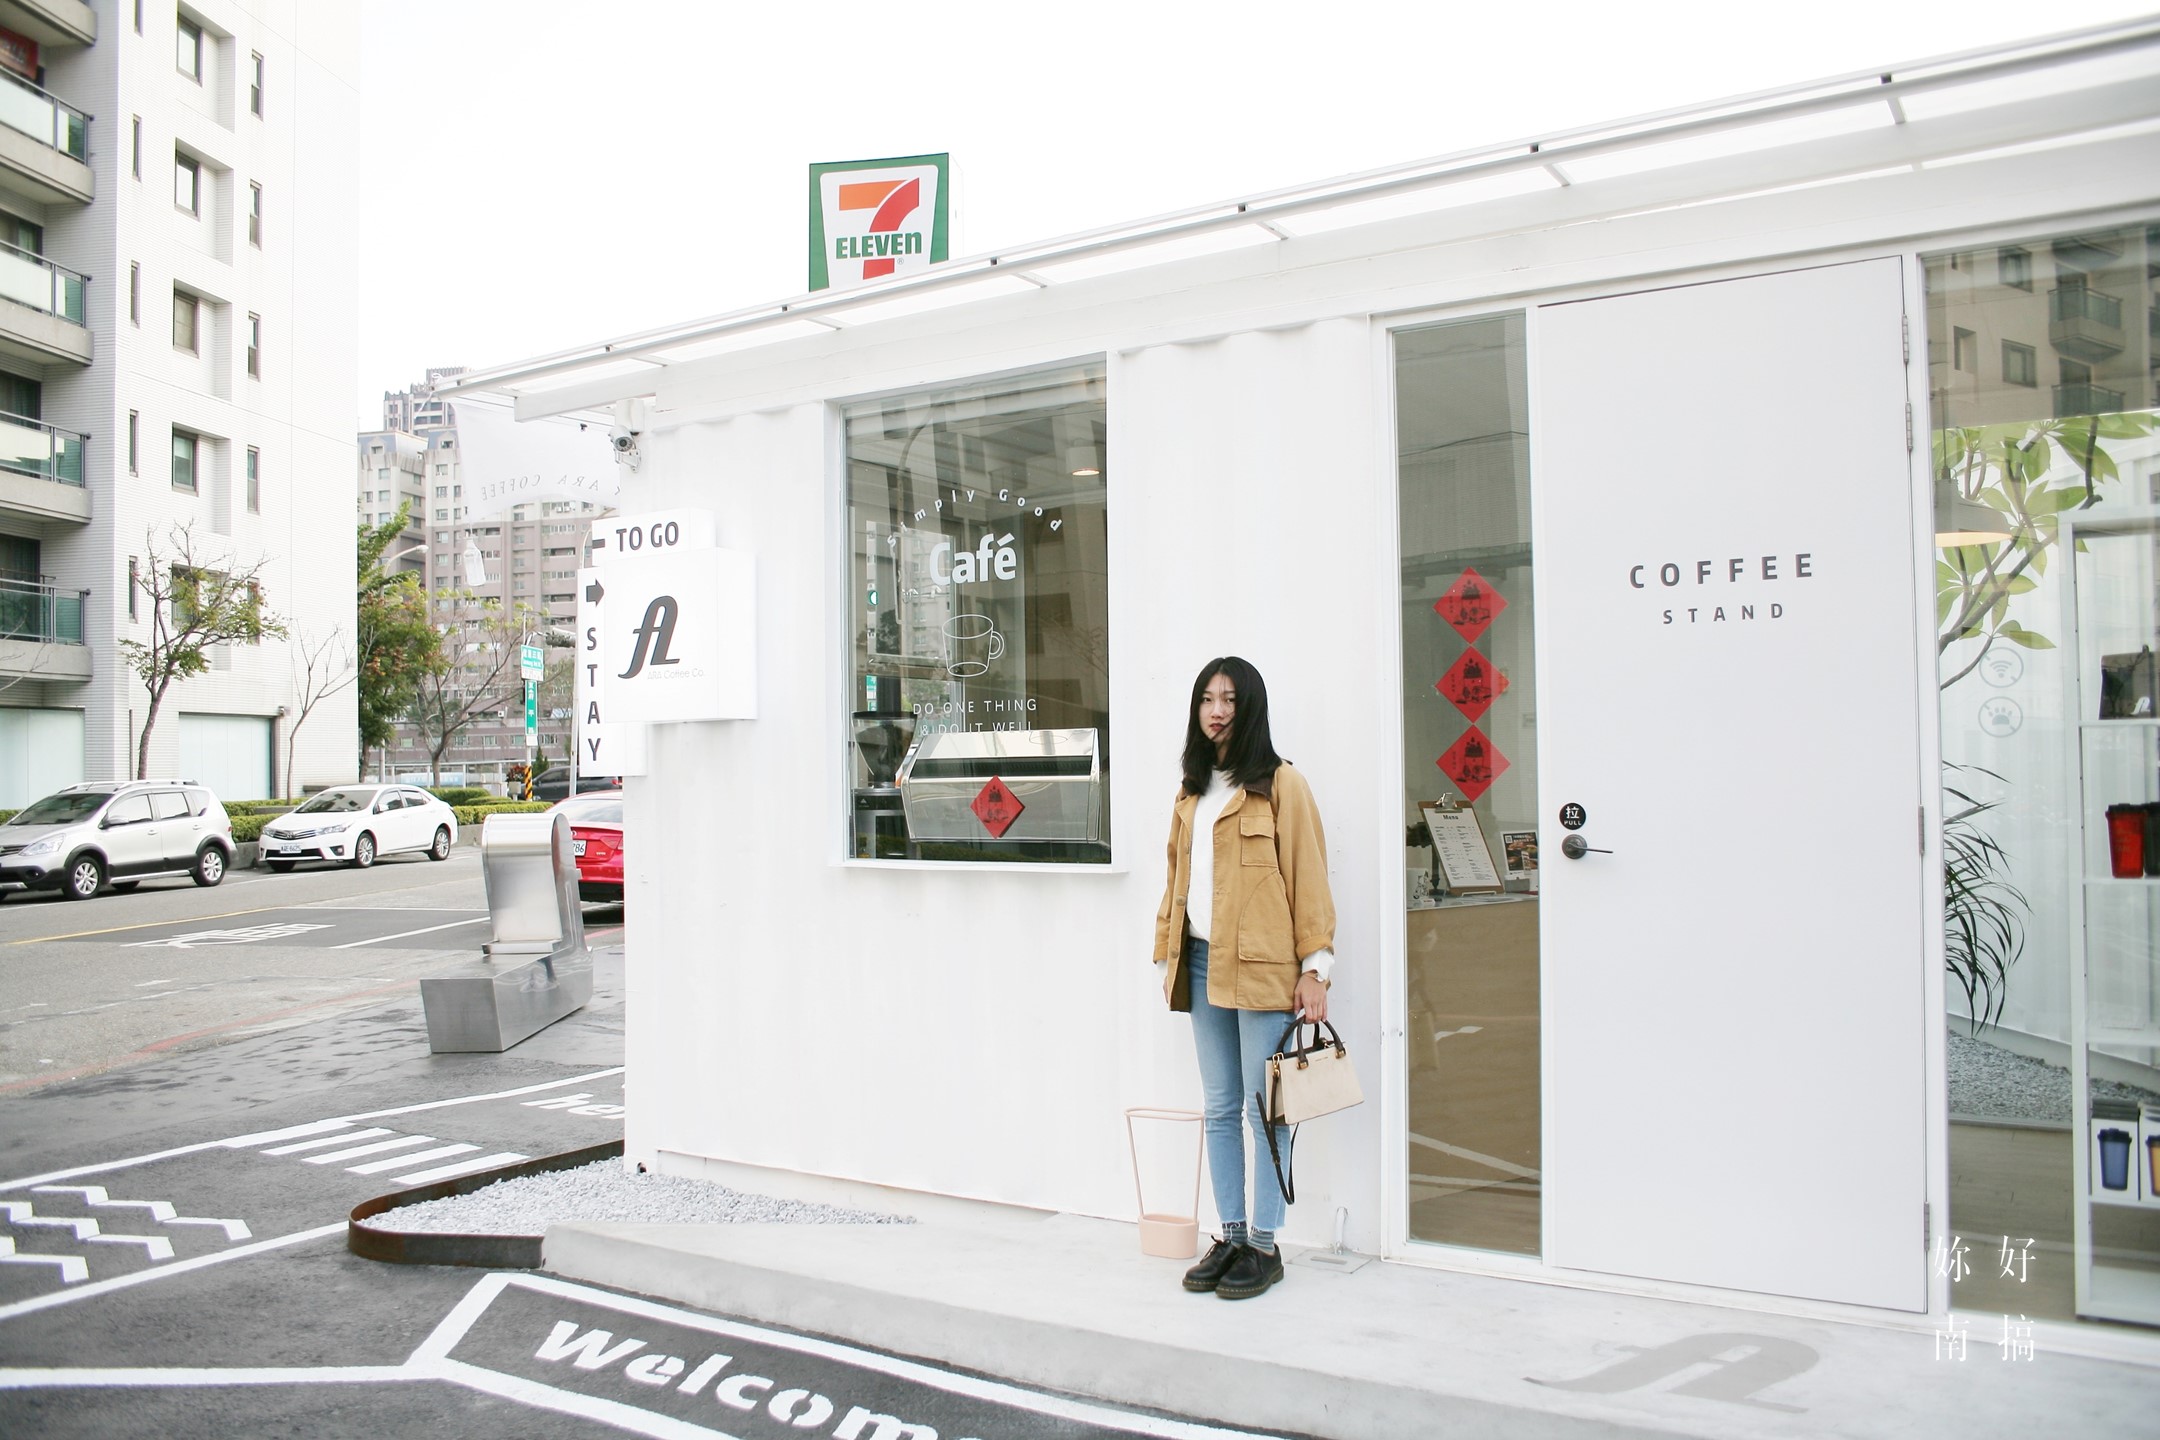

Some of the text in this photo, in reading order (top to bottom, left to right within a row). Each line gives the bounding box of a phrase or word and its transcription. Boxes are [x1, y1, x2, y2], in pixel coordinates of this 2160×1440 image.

[839, 177, 920, 280] 7
[999, 488, 1062, 532] Good
[615, 521, 680, 552] TO GO
[929, 532, 1017, 586] Café
[1629, 553, 1812, 589] COFFEE
[1662, 603, 1784, 625] STAND
[663, 669, 691, 680] Coffee
[586, 626, 602, 762] STAY
[913, 698, 1037, 715] DO ONE THING
[1565, 805, 1580, 819] 拉
[572, 843, 585, 853] 86
[534, 1319, 996, 1440] Welcom
